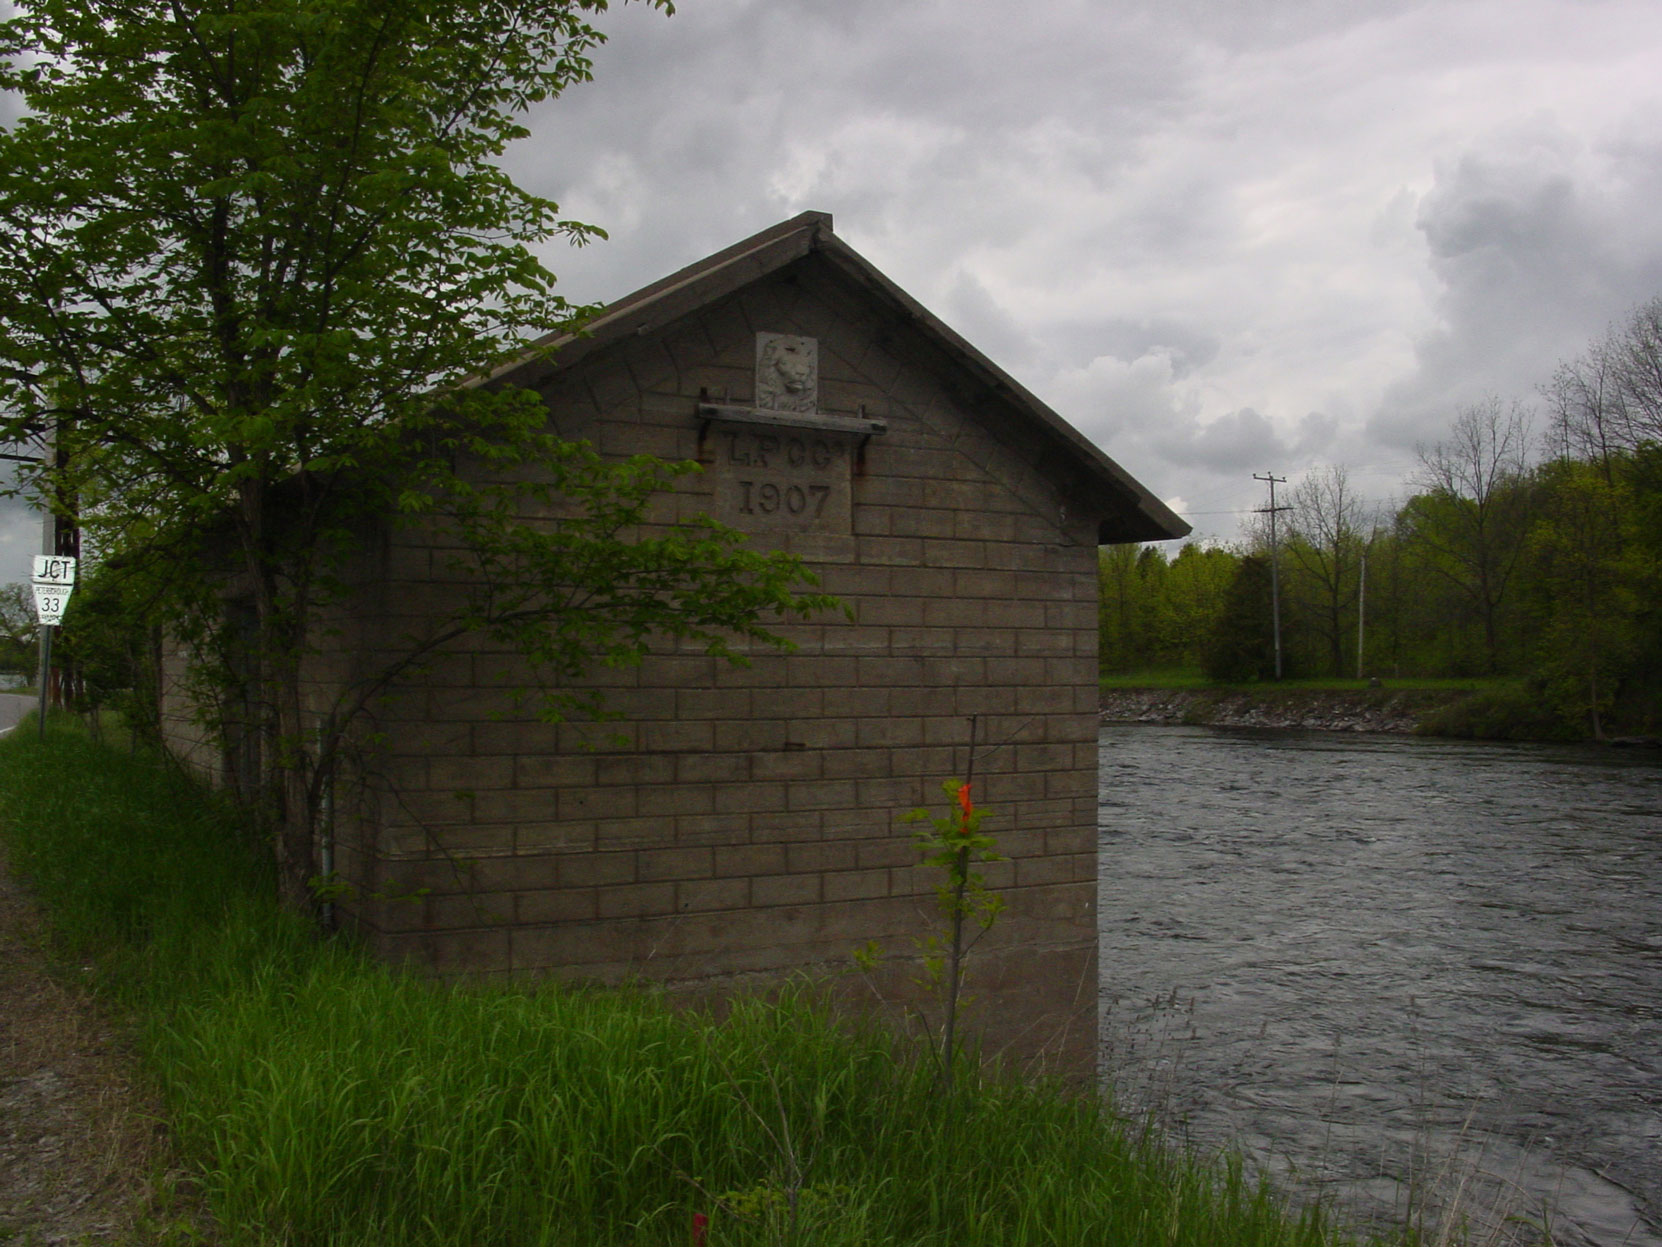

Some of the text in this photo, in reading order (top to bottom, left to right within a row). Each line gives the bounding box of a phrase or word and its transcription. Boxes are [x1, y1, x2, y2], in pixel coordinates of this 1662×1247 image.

[738, 481, 831, 518] 1907
[38, 560, 70, 579] JCT
[42, 598, 60, 612] 33
